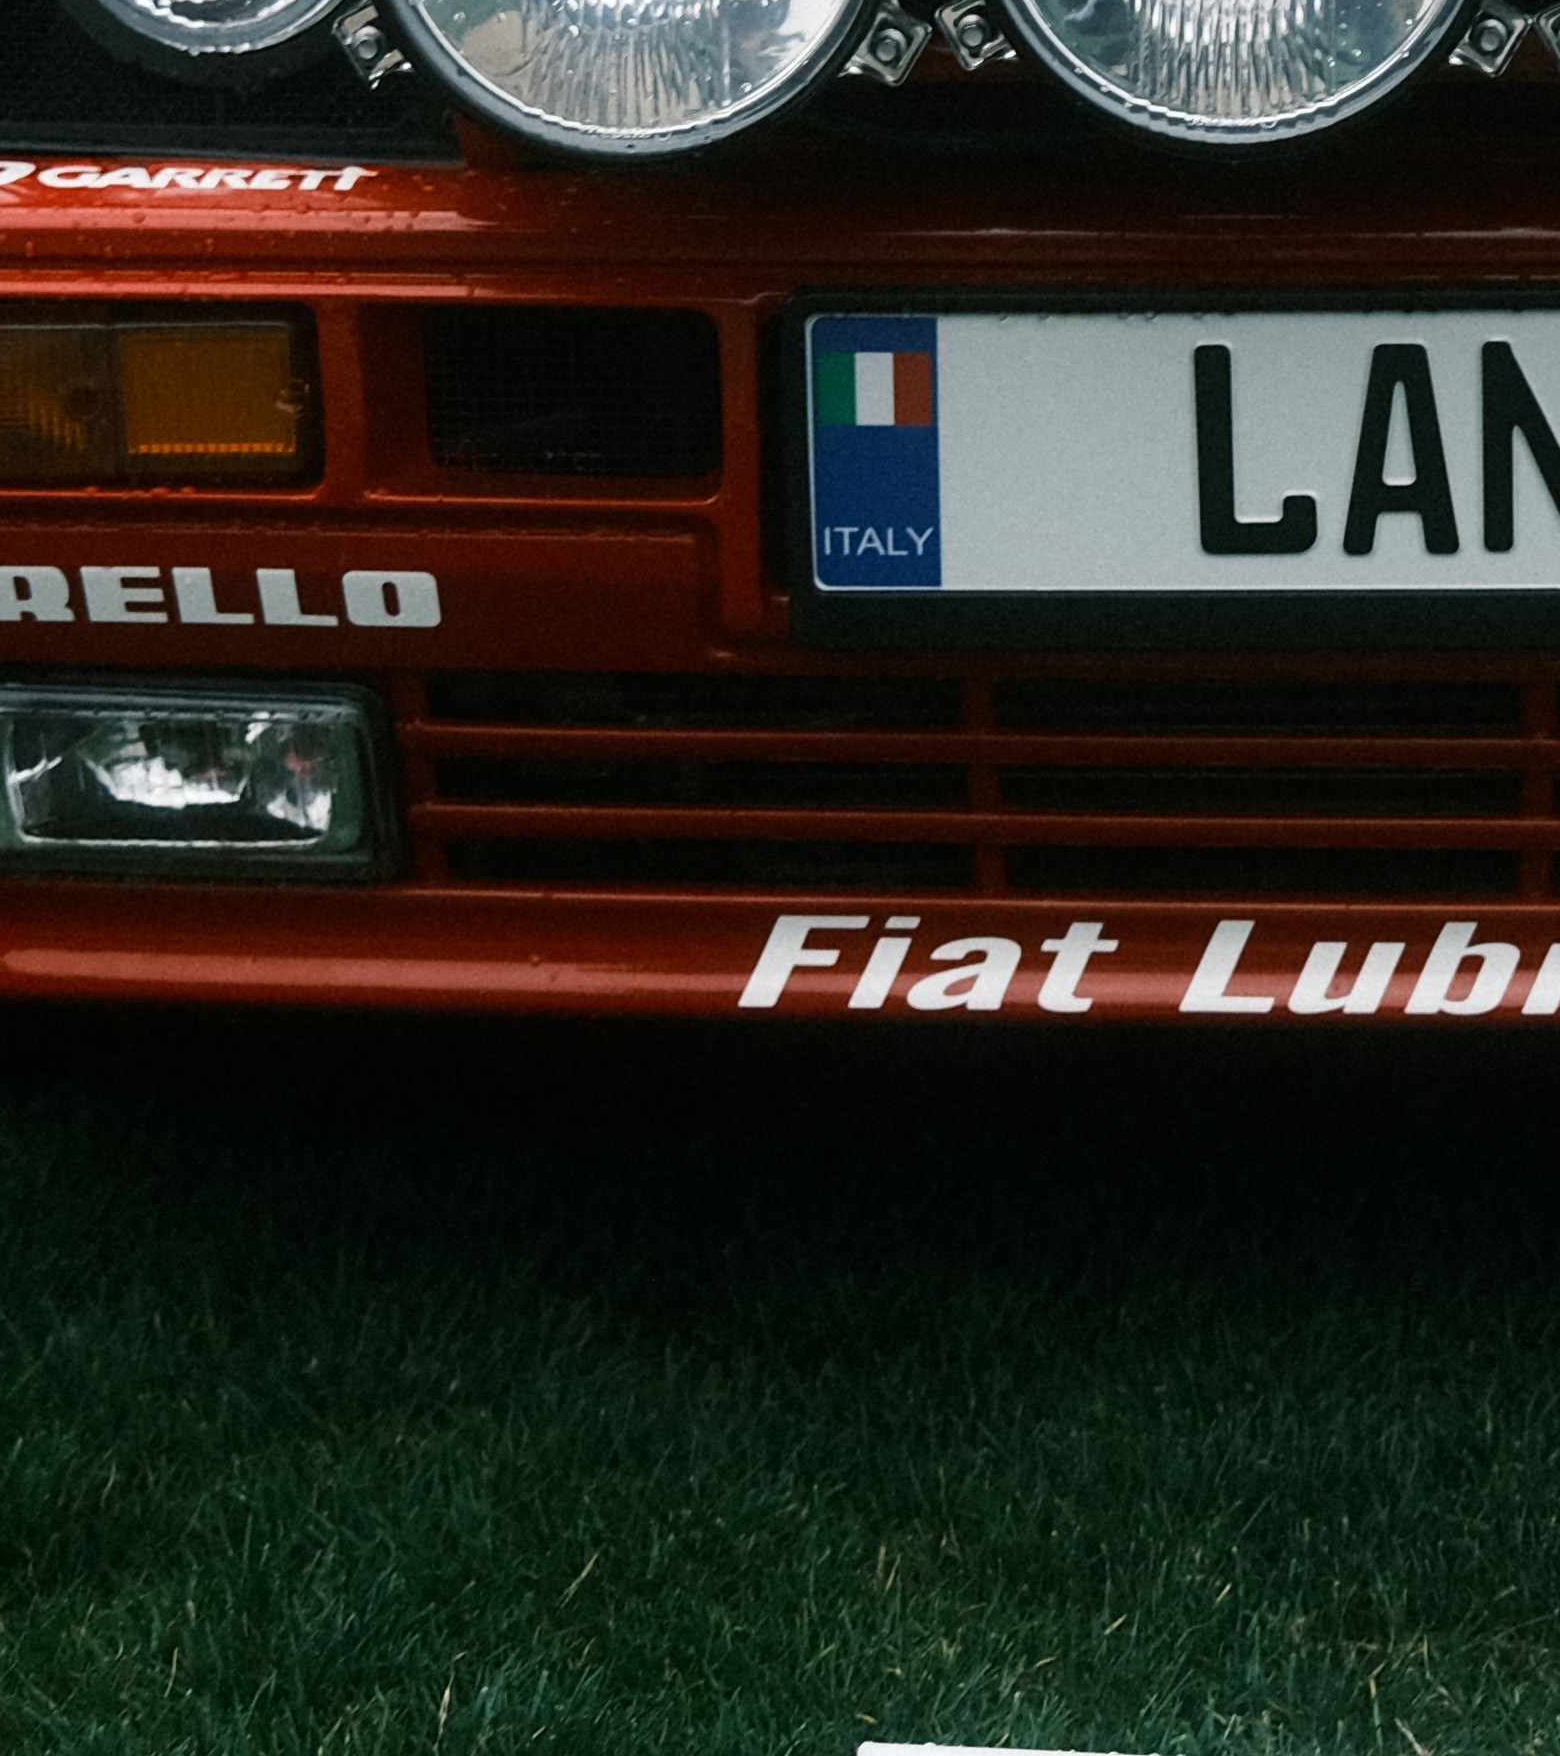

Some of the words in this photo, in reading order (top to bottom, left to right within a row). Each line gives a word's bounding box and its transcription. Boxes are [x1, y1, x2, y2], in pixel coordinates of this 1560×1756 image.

[38, 165, 378, 192] GARRETT
[823, 525, 935, 557] ITALY
[737, 914, 1119, 1014] Fiat
